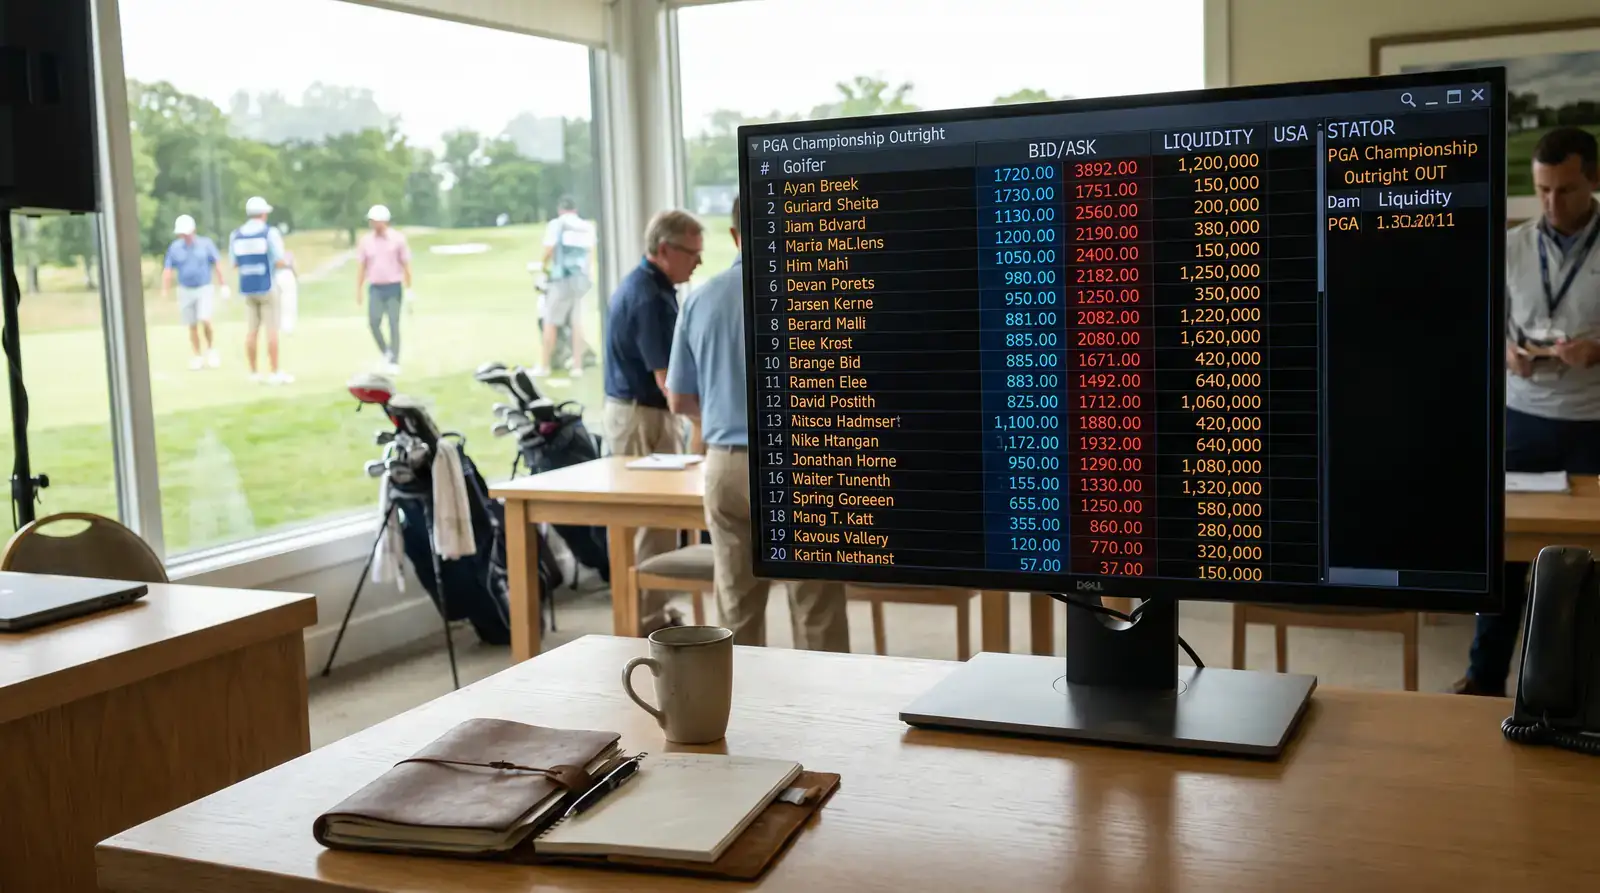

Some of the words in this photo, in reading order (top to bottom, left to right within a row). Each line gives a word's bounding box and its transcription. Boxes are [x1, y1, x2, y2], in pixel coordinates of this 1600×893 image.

[763, 138, 789, 153] PGA
[792, 131, 885, 151] Championship
[889, 126, 946, 144] Outright
[1328, 119, 1396, 139] STATOR
[760, 161, 770, 175] #
[783, 157, 826, 174] Goifer
[1029, 139, 1097, 159] BID/ASK
[1164, 128, 1254, 151] LIQUIDITY
[1274, 125, 1308, 142] USA
[1328, 147, 1359, 162] PGA
[1365, 140, 1477, 160] Championship
[768, 183, 775, 195] 1
[784, 181, 815, 196] Ayan
[820, 177, 858, 192] Breek
[994, 165, 1054, 182] 1720.00
[1075, 160, 1138, 178] 3892.00
[1179, 153, 1259, 174] 1,200,000
[1344, 168, 1408, 185] Outright
[1415, 165, 1447, 180] OUT
[768, 202, 775, 214] 2
[837, 197, 879, 211] Sheita
[994, 186, 1054, 203] 1730.00
[1076, 182, 1138, 198] 1751.00
[1194, 176, 1259, 193] 150,000
[1328, 195, 1360, 209] Dam
[1379, 189, 1452, 209] Liquidity
[768, 221, 775, 234] 3
[995, 207, 1055, 223] 1130.00
[1075, 203, 1138, 220] 2560.00
[1194, 197, 1259, 215] 200,000
[1328, 216, 1359, 231] PGA
[768, 241, 776, 253] 4
[995, 228, 1055, 244] 1200.00
[1076, 225, 1138, 241] 2190.00
[1195, 220, 1260, 237] 380,000
[769, 260, 776, 273] 5
[787, 259, 812, 272] Him
[818, 257, 848, 271] Mahi
[995, 249, 1055, 265] 1050.00
[1076, 246, 1139, 262] 2400.00
[1196, 242, 1260, 259] 150,000
[770, 280, 777, 292] 6
[787, 279, 826, 292] Devan
[832, 277, 875, 290] Porets
[1005, 270, 1056, 285] 980.00
[1077, 268, 1139, 283] 2182.00
[1180, 264, 1260, 282] 1,250,000
[770, 299, 778, 311] 7
[787, 298, 829, 311] Jarsen
[834, 297, 873, 310] Kerne
[1005, 291, 1056, 306] 950.00
[1078, 289, 1139, 304] 1250.00
[1195, 286, 1260, 303] 350,000
[771, 318, 779, 331] 8
[788, 317, 831, 331] Berard
[836, 316, 866, 330] Malli
[1005, 312, 1057, 326] 881.00
[1078, 310, 1140, 325] 2082.00
[1181, 308, 1260, 325] 1,220,000
[772, 337, 779, 350] 9
[789, 337, 815, 350] Elee
[820, 337, 853, 350] Krost
[1006, 333, 1057, 347] 885.00
[1078, 331, 1140, 346] 2080.00
[1181, 329, 1260, 347] 1,620,000
[765, 357, 780, 369] 10
[789, 356, 835, 372] Brange
[840, 355, 860, 369] Bid
[1006, 353, 1057, 367] 885.00
[1080, 353, 1140, 367] 1671.00
[1195, 351, 1261, 368] 420,000
[766, 376, 780, 388] 11
[790, 376, 834, 388] Ramen
[840, 375, 867, 388] Elee
[1007, 374, 1058, 388] 883.00
[1080, 374, 1141, 388] 1492.00
[1196, 373, 1261, 390] 640,000
[766, 395, 781, 407] 12
[791, 395, 825, 408] David
[830, 395, 875, 408] Postith
[1007, 395, 1058, 409] 825.00
[1080, 395, 1141, 409] 1712.00
[1182, 395, 1261, 411] 1,060,000
[767, 414, 782, 426] 13
[995, 415, 1059, 431] 1,100.00
[1080, 416, 1141, 430] 1880.00
[1196, 416, 1261, 433] 420,000
[768, 433, 782, 445] 14
[792, 433, 819, 447] Nike
[824, 434, 879, 450] Htangan
[1080, 436, 1142, 451] 1932.00
[1196, 438, 1261, 455] 640,000
[768, 453, 783, 465] 15
[792, 453, 852, 466] Jonathan
[857, 454, 896, 467] Horne
[1008, 456, 1059, 470] 950.00
[1081, 457, 1142, 472] 1290.00
[1183, 459, 1262, 476] 1,080,000
[769, 472, 784, 484] 16
[837, 473, 890, 487] Tunenth
[1009, 476, 1059, 491] 155.00
[1081, 478, 1142, 492] 1330.00
[1183, 480, 1262, 497] 1,320,000
[770, 491, 784, 503] 17
[793, 491, 834, 508] Spring
[838, 493, 894, 506] Goreeen
[1009, 496, 1060, 511] 655.00
[1082, 499, 1142, 514] 1250.00
[1198, 502, 1262, 519] 580,000
[770, 510, 785, 522] 18
[793, 510, 826, 527] Mang
[830, 512, 842, 524] T.
[847, 512, 874, 525] Katt
[1010, 517, 1060, 531] 355.00
[1090, 519, 1142, 534] 860.00
[1198, 523, 1262, 540] 280,000
[771, 529, 785, 541] 19
[794, 530, 840, 543] Kavous
[844, 531, 888, 548] Vallery
[1011, 537, 1060, 552] 120.00
[1091, 540, 1143, 555] 770.00
[1198, 544, 1262, 561] 320,000
[771, 547, 786, 560] 20
[795, 549, 832, 562] Kartin
[837, 550, 894, 565] Nethanst
[1020, 558, 1061, 572] 57.00
[1101, 561, 1143, 576] 37.00
